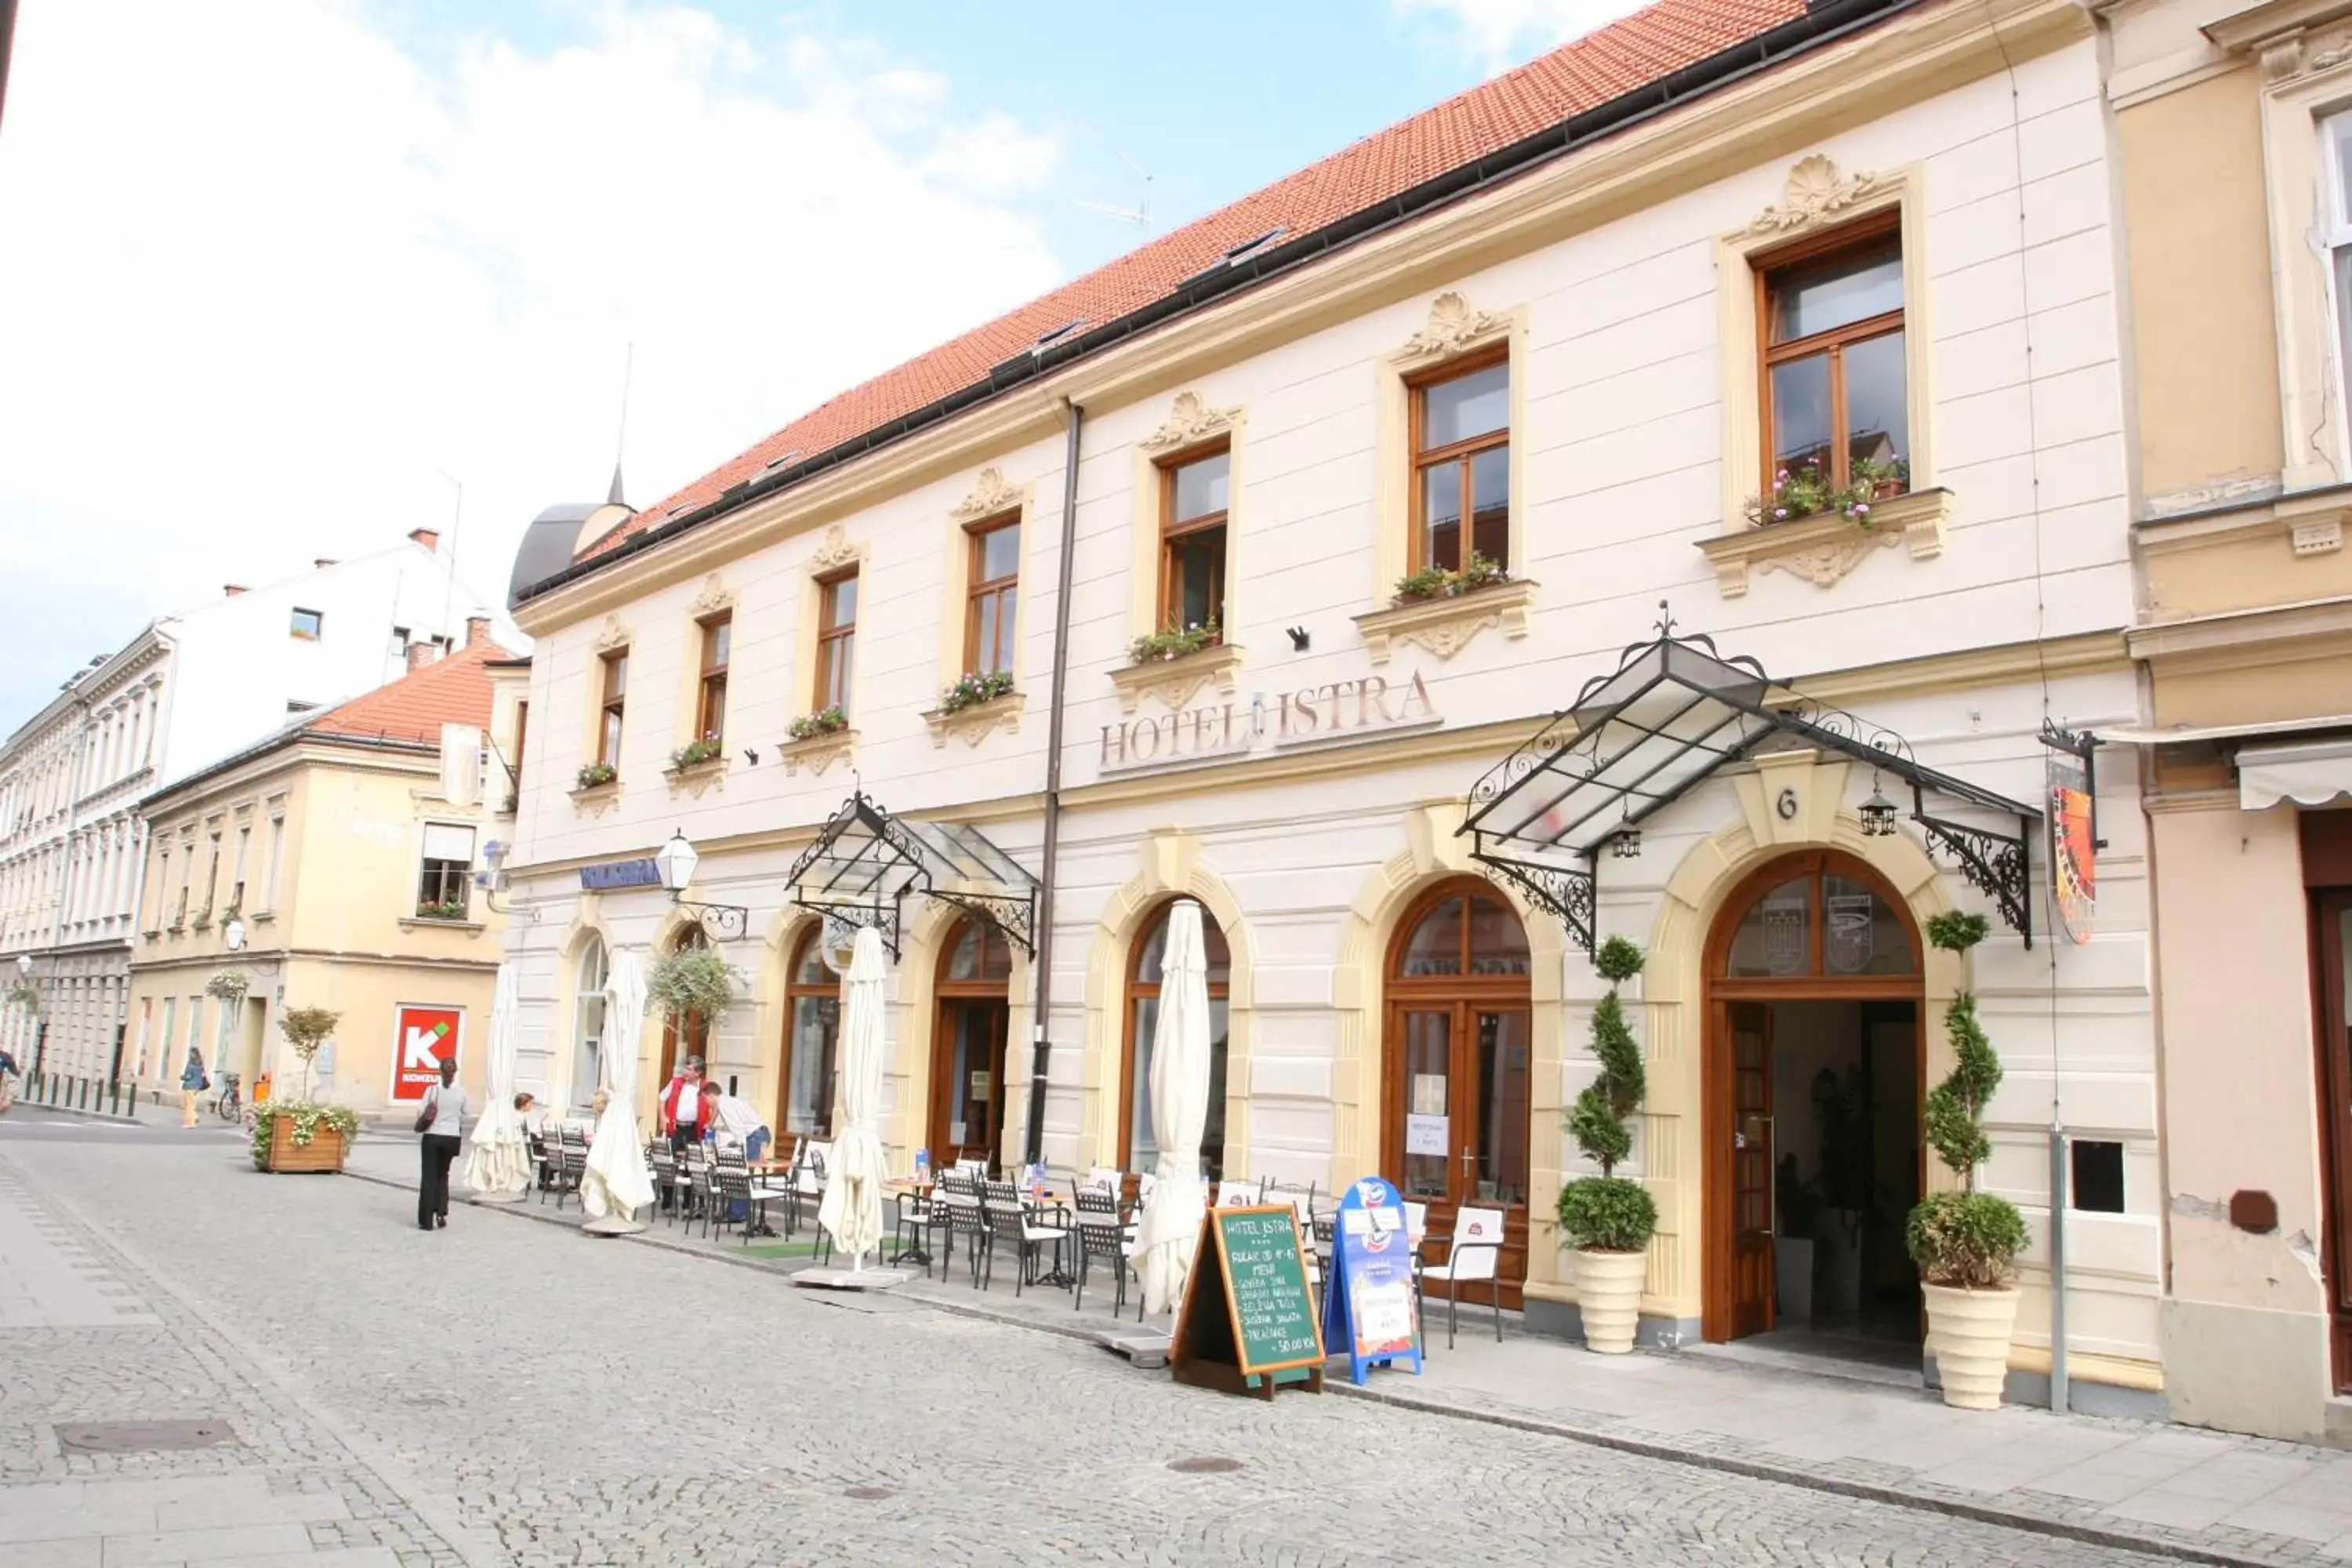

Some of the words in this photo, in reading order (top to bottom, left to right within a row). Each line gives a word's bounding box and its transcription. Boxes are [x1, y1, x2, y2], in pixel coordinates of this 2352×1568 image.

[1100, 702, 1250, 766] HOTEL
[1277, 668, 1436, 739] ISTRA
[1777, 789, 1797, 820] 6
[1226, 1220, 1261, 1236] HOTEL
